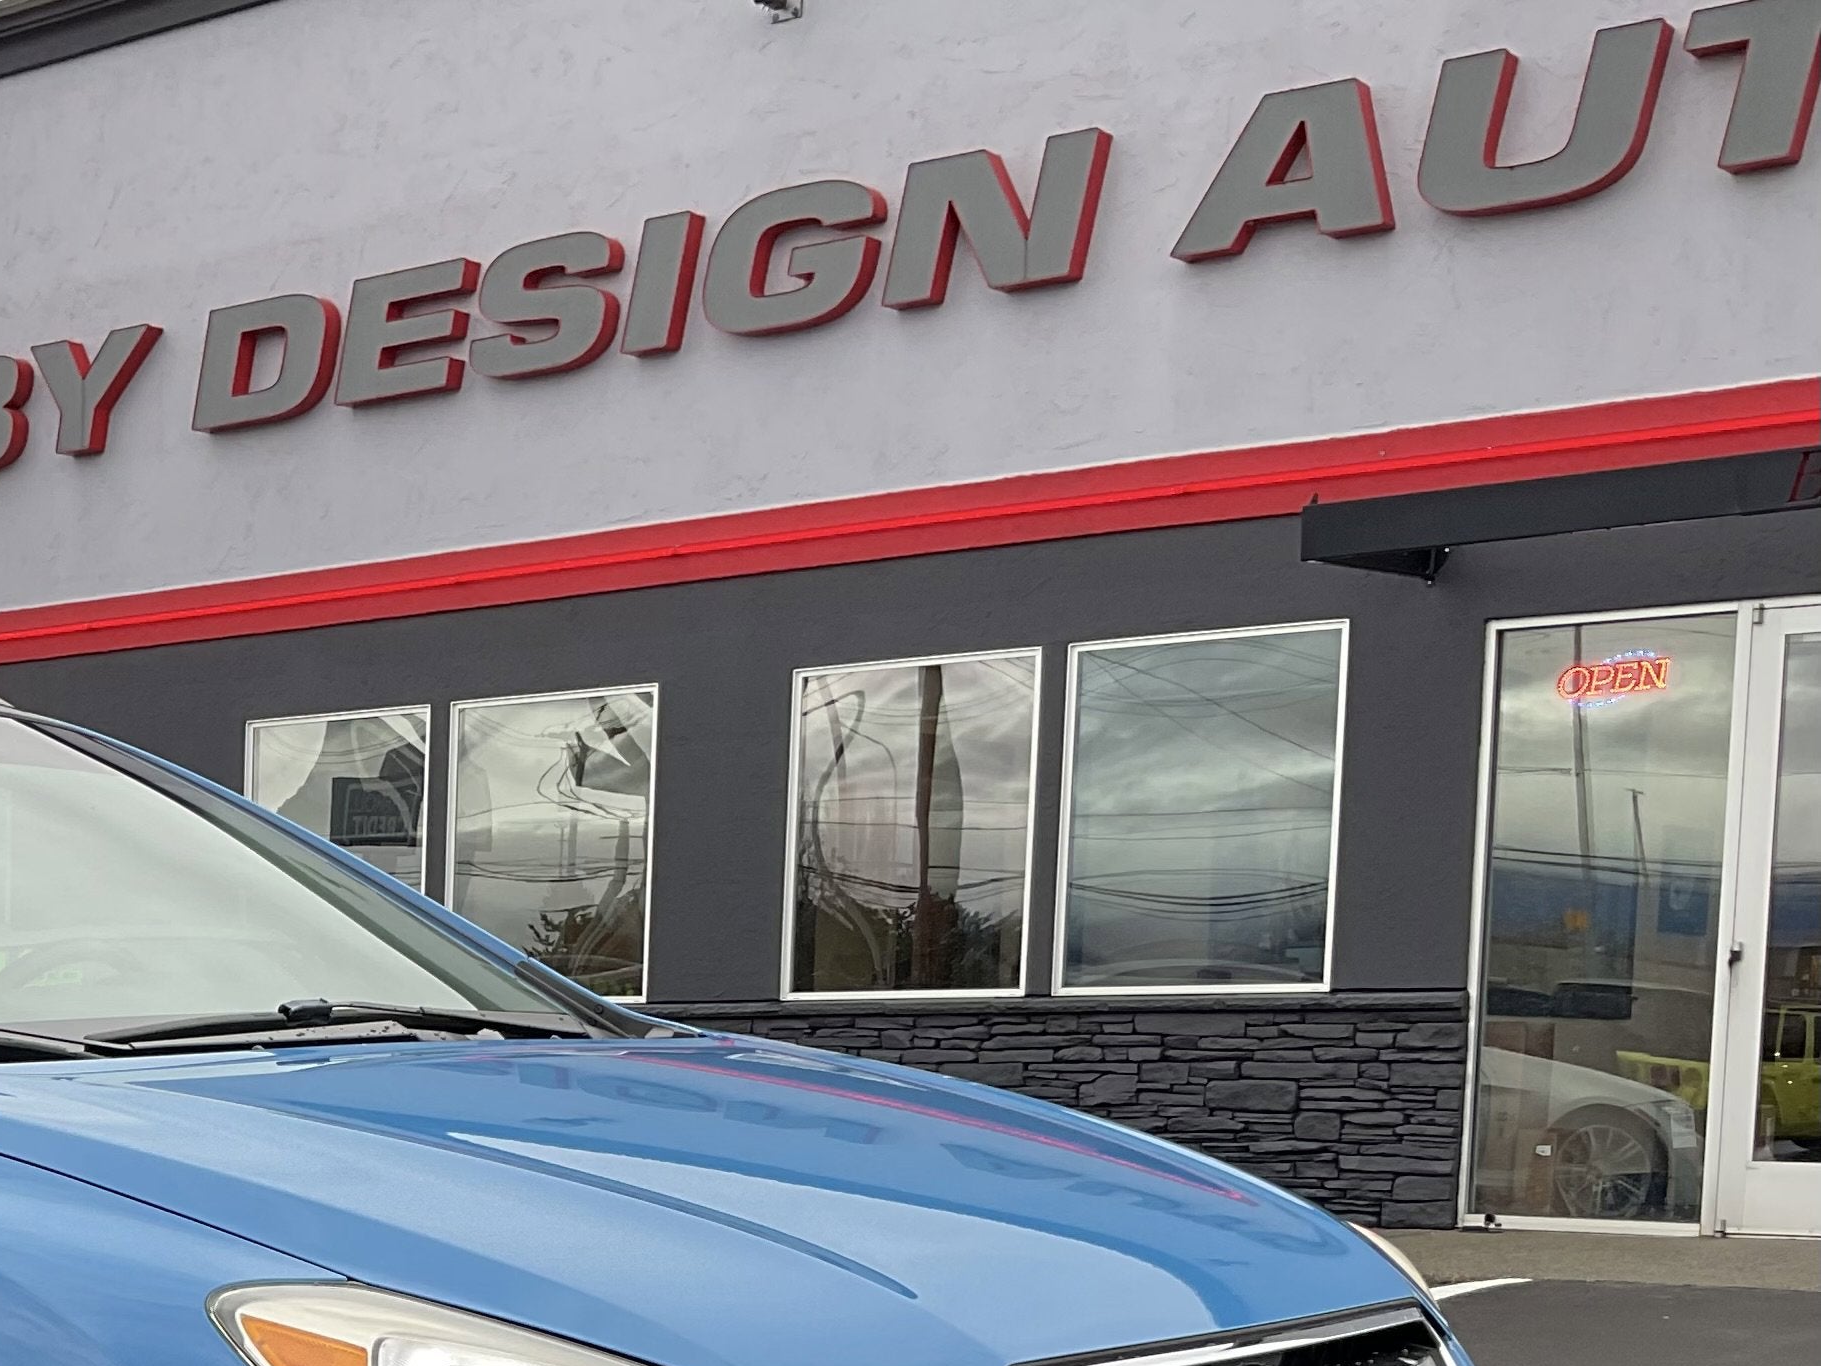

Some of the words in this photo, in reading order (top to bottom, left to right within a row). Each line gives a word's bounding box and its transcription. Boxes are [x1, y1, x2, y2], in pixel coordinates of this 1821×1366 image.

[191, 126, 1115, 434] DESIGN
[1170, 0, 1821, 263] AUT
[1557, 656, 1672, 699] OPEN
